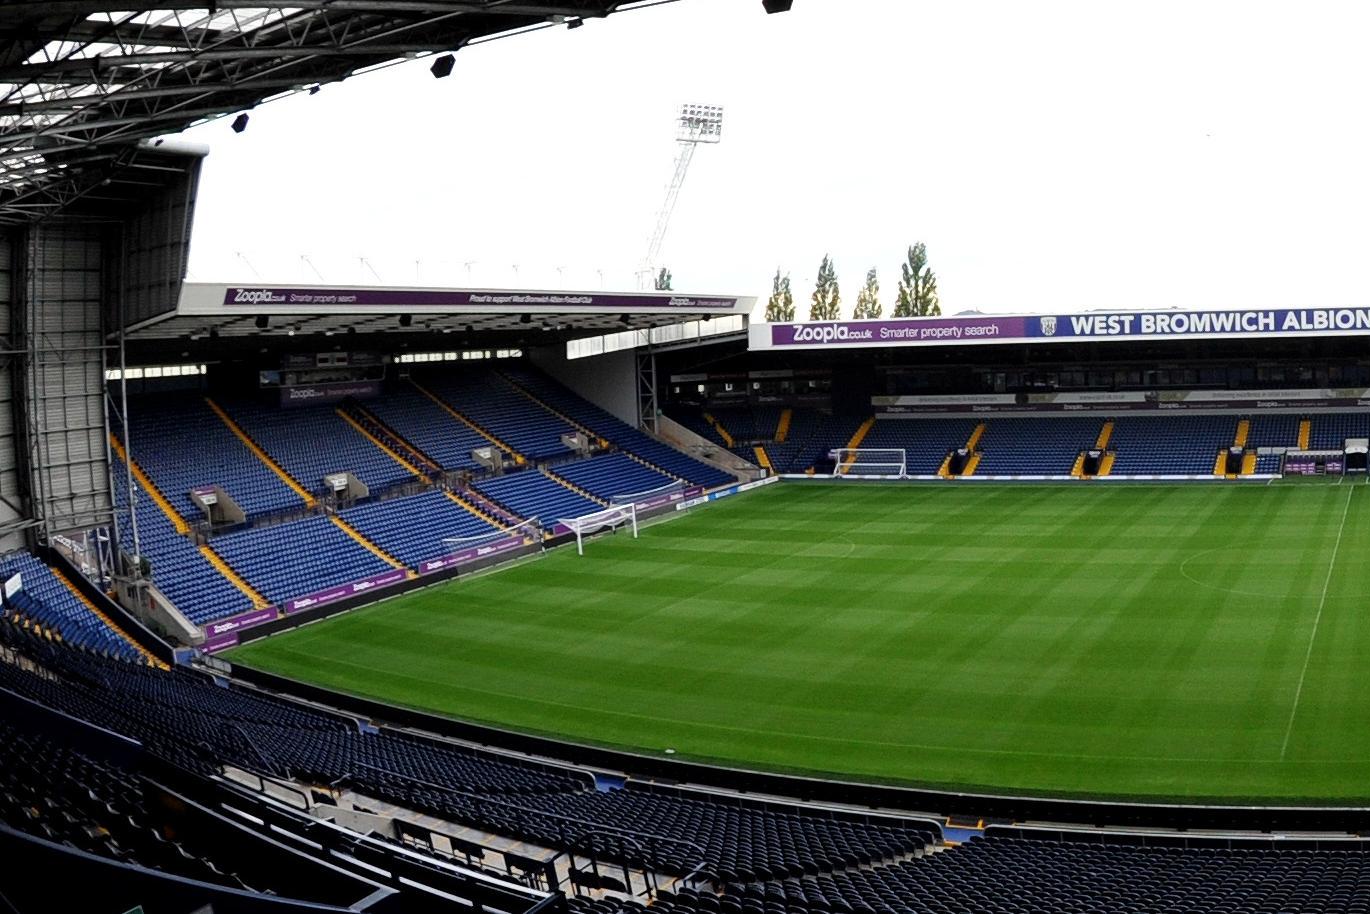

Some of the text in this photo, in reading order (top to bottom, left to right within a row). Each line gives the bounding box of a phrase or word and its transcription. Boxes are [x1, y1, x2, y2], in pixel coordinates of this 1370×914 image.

[792, 323, 999, 343] Zoopla.co.uk Smarter property search
[1071, 315, 1134, 335] WEST
[1140, 311, 1275, 334] BROMWICH
